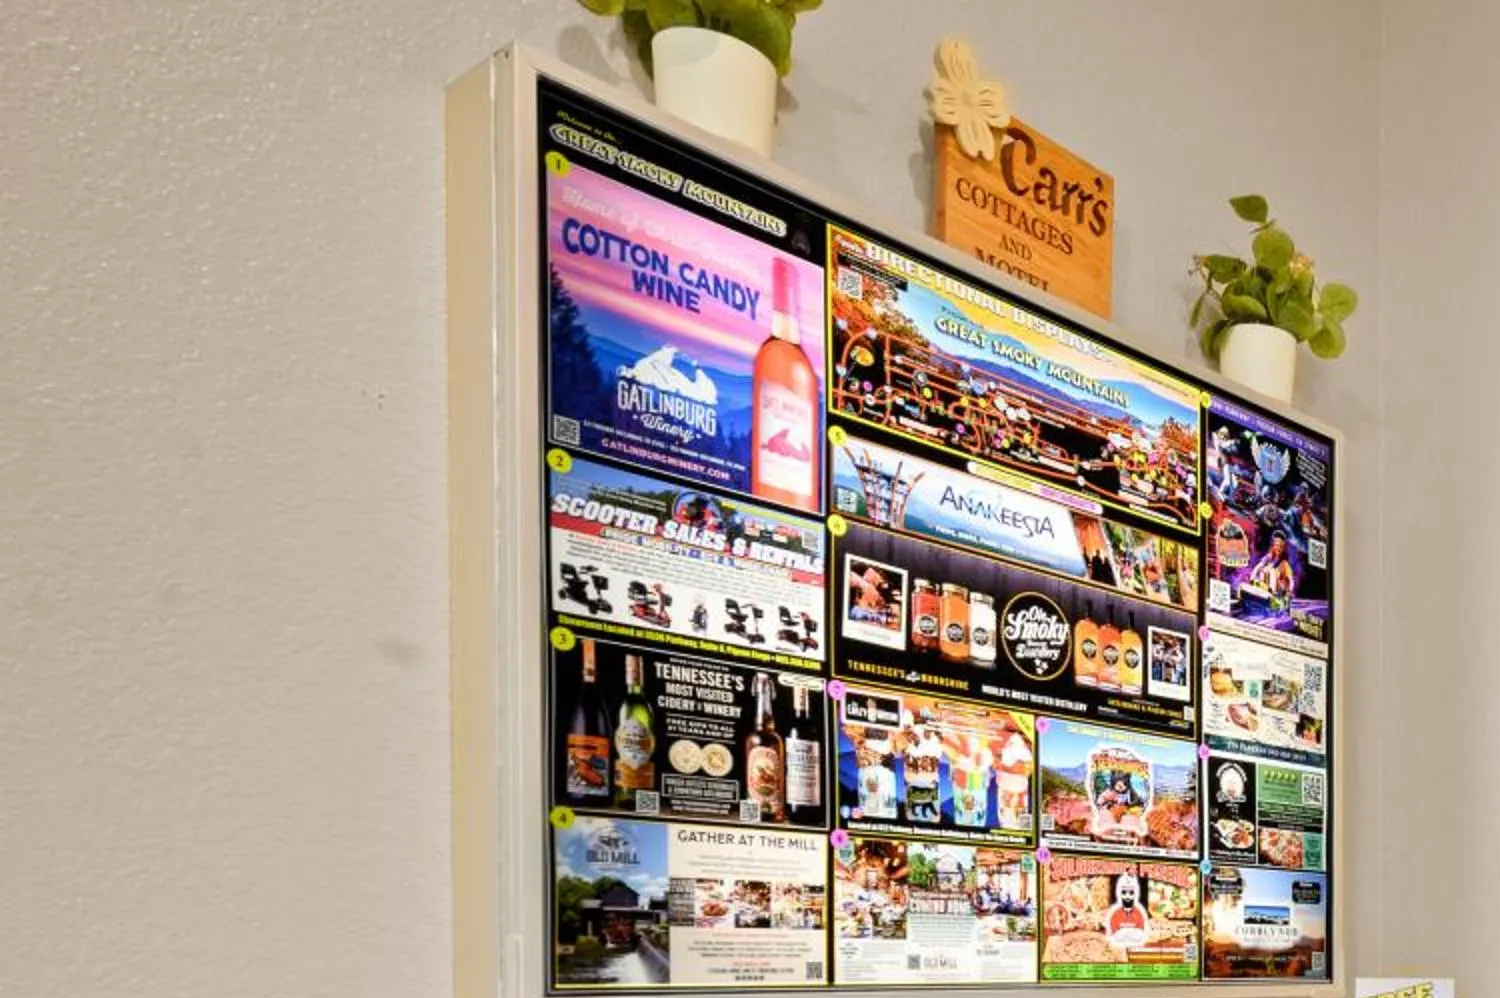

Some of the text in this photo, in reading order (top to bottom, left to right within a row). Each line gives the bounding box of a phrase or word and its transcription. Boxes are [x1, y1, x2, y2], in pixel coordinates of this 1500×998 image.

[551, 124, 620, 164] GREAT
[1000, 127, 1109, 237] Carr's
[955, 177, 1074, 256] COTTAGES
[562, 217, 669, 277] COTTON
[679, 263, 761, 320] CANDY
[999, 234, 1033, 261] AND
[631, 268, 700, 313] WINE
[935, 315, 990, 351] GREAT
[991, 340, 1043, 373] SMOKY
[617, 380, 717, 437] GATLINBURG
[640, 413, 694, 443] Winery
[552, 493, 660, 536] SCOOTER
[663, 519, 727, 552] SALES
[939, 485, 1055, 538] ANAKEESTA
[1005, 606, 1070, 645] Smoky
[654, 661, 745, 692] TENNESSEE'S
[665, 681, 694, 698] MOST
[703, 702, 742, 719] WINERY
[677, 829, 818, 852] GATHER AT THE MILL
